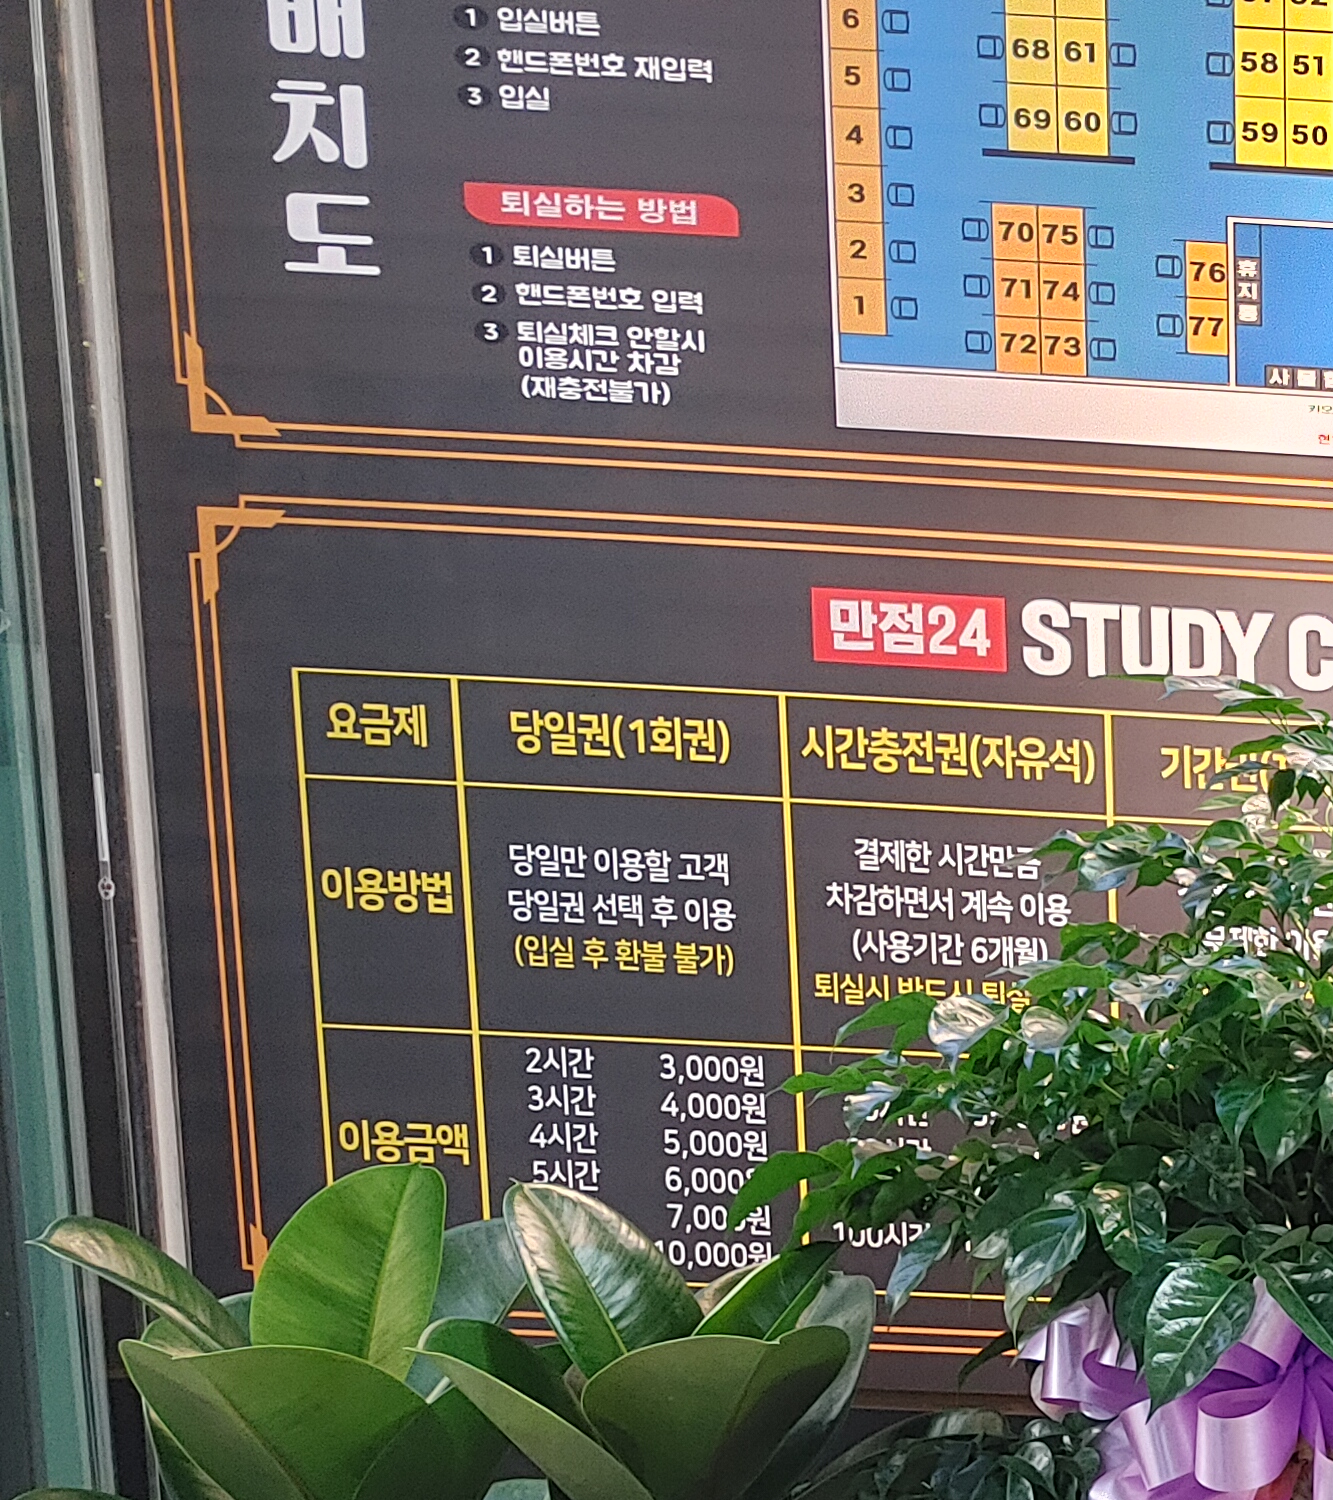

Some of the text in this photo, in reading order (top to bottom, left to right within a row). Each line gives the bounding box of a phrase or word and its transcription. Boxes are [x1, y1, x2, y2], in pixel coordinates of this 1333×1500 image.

[497, 7, 600, 37] 입실버튼
[843, 10, 859, 28] 6
[497, 48, 627, 79] 핸드폰번호
[634, 56, 713, 84] 재입력
[1012, 39, 1096, 64] 68 61
[1241, 53, 1324, 77] 58 51
[844, 67, 861, 86] 5
[498, 85, 550, 111] 입실
[845, 125, 863, 144] 4
[1013, 108, 1101, 133] 69 60
[1241, 123, 1328, 146] 59 50
[500, 190, 697, 226] 퇴실하는 방법
[847, 184, 865, 202] 3
[999, 222, 1078, 246] 70 75
[512, 244, 616, 273] 퇴실버튼
[850, 241, 867, 259] 2
[1190, 261, 1226, 282] 76
[515, 284, 641, 312] 핸드폰번호
[651, 288, 704, 316] 입력
[853, 296, 865, 315] 1
[1001, 278, 1079, 302] 71 74
[517, 321, 619, 348] 퇴실체크
[627, 326, 705, 354] 안할시
[1189, 316, 1224, 337] 77
[1000, 333, 1081, 357] 72 73
[518, 348, 680, 377] 이용시간 차감
[521, 375, 670, 406] (재충전불가)
[828, 598, 991, 657] 만점24
[1021, 599, 1275, 682] STUDY
[326, 702, 428, 748] 요금제
[509, 709, 731, 765] 당일권(1회권)
[801, 724, 1096, 784] 시간충전권(자유석)
[509, 843, 730, 886] 당일만 이용할 고객
[854, 838, 931, 874] 결제한
[320, 866, 455, 915] 이용방법
[826, 882, 1072, 928] 차감하면서 계속 이용
[508, 890, 737, 933] 당일권 선택 후 이용
[514, 935, 734, 978] (입실 후 환불 불가)
[852, 928, 964, 966] (사용기간
[814, 972, 889, 1006] 퇴실시
[525, 1047, 765, 1087] 2시간 3,000원
[527, 1085, 767, 1125] 3시간 4,000원
[339, 1119, 470, 1165] 이용금액
[529, 1122, 768, 1162] 4시간 5,000원
[665, 1167, 757, 1197] 6,000
